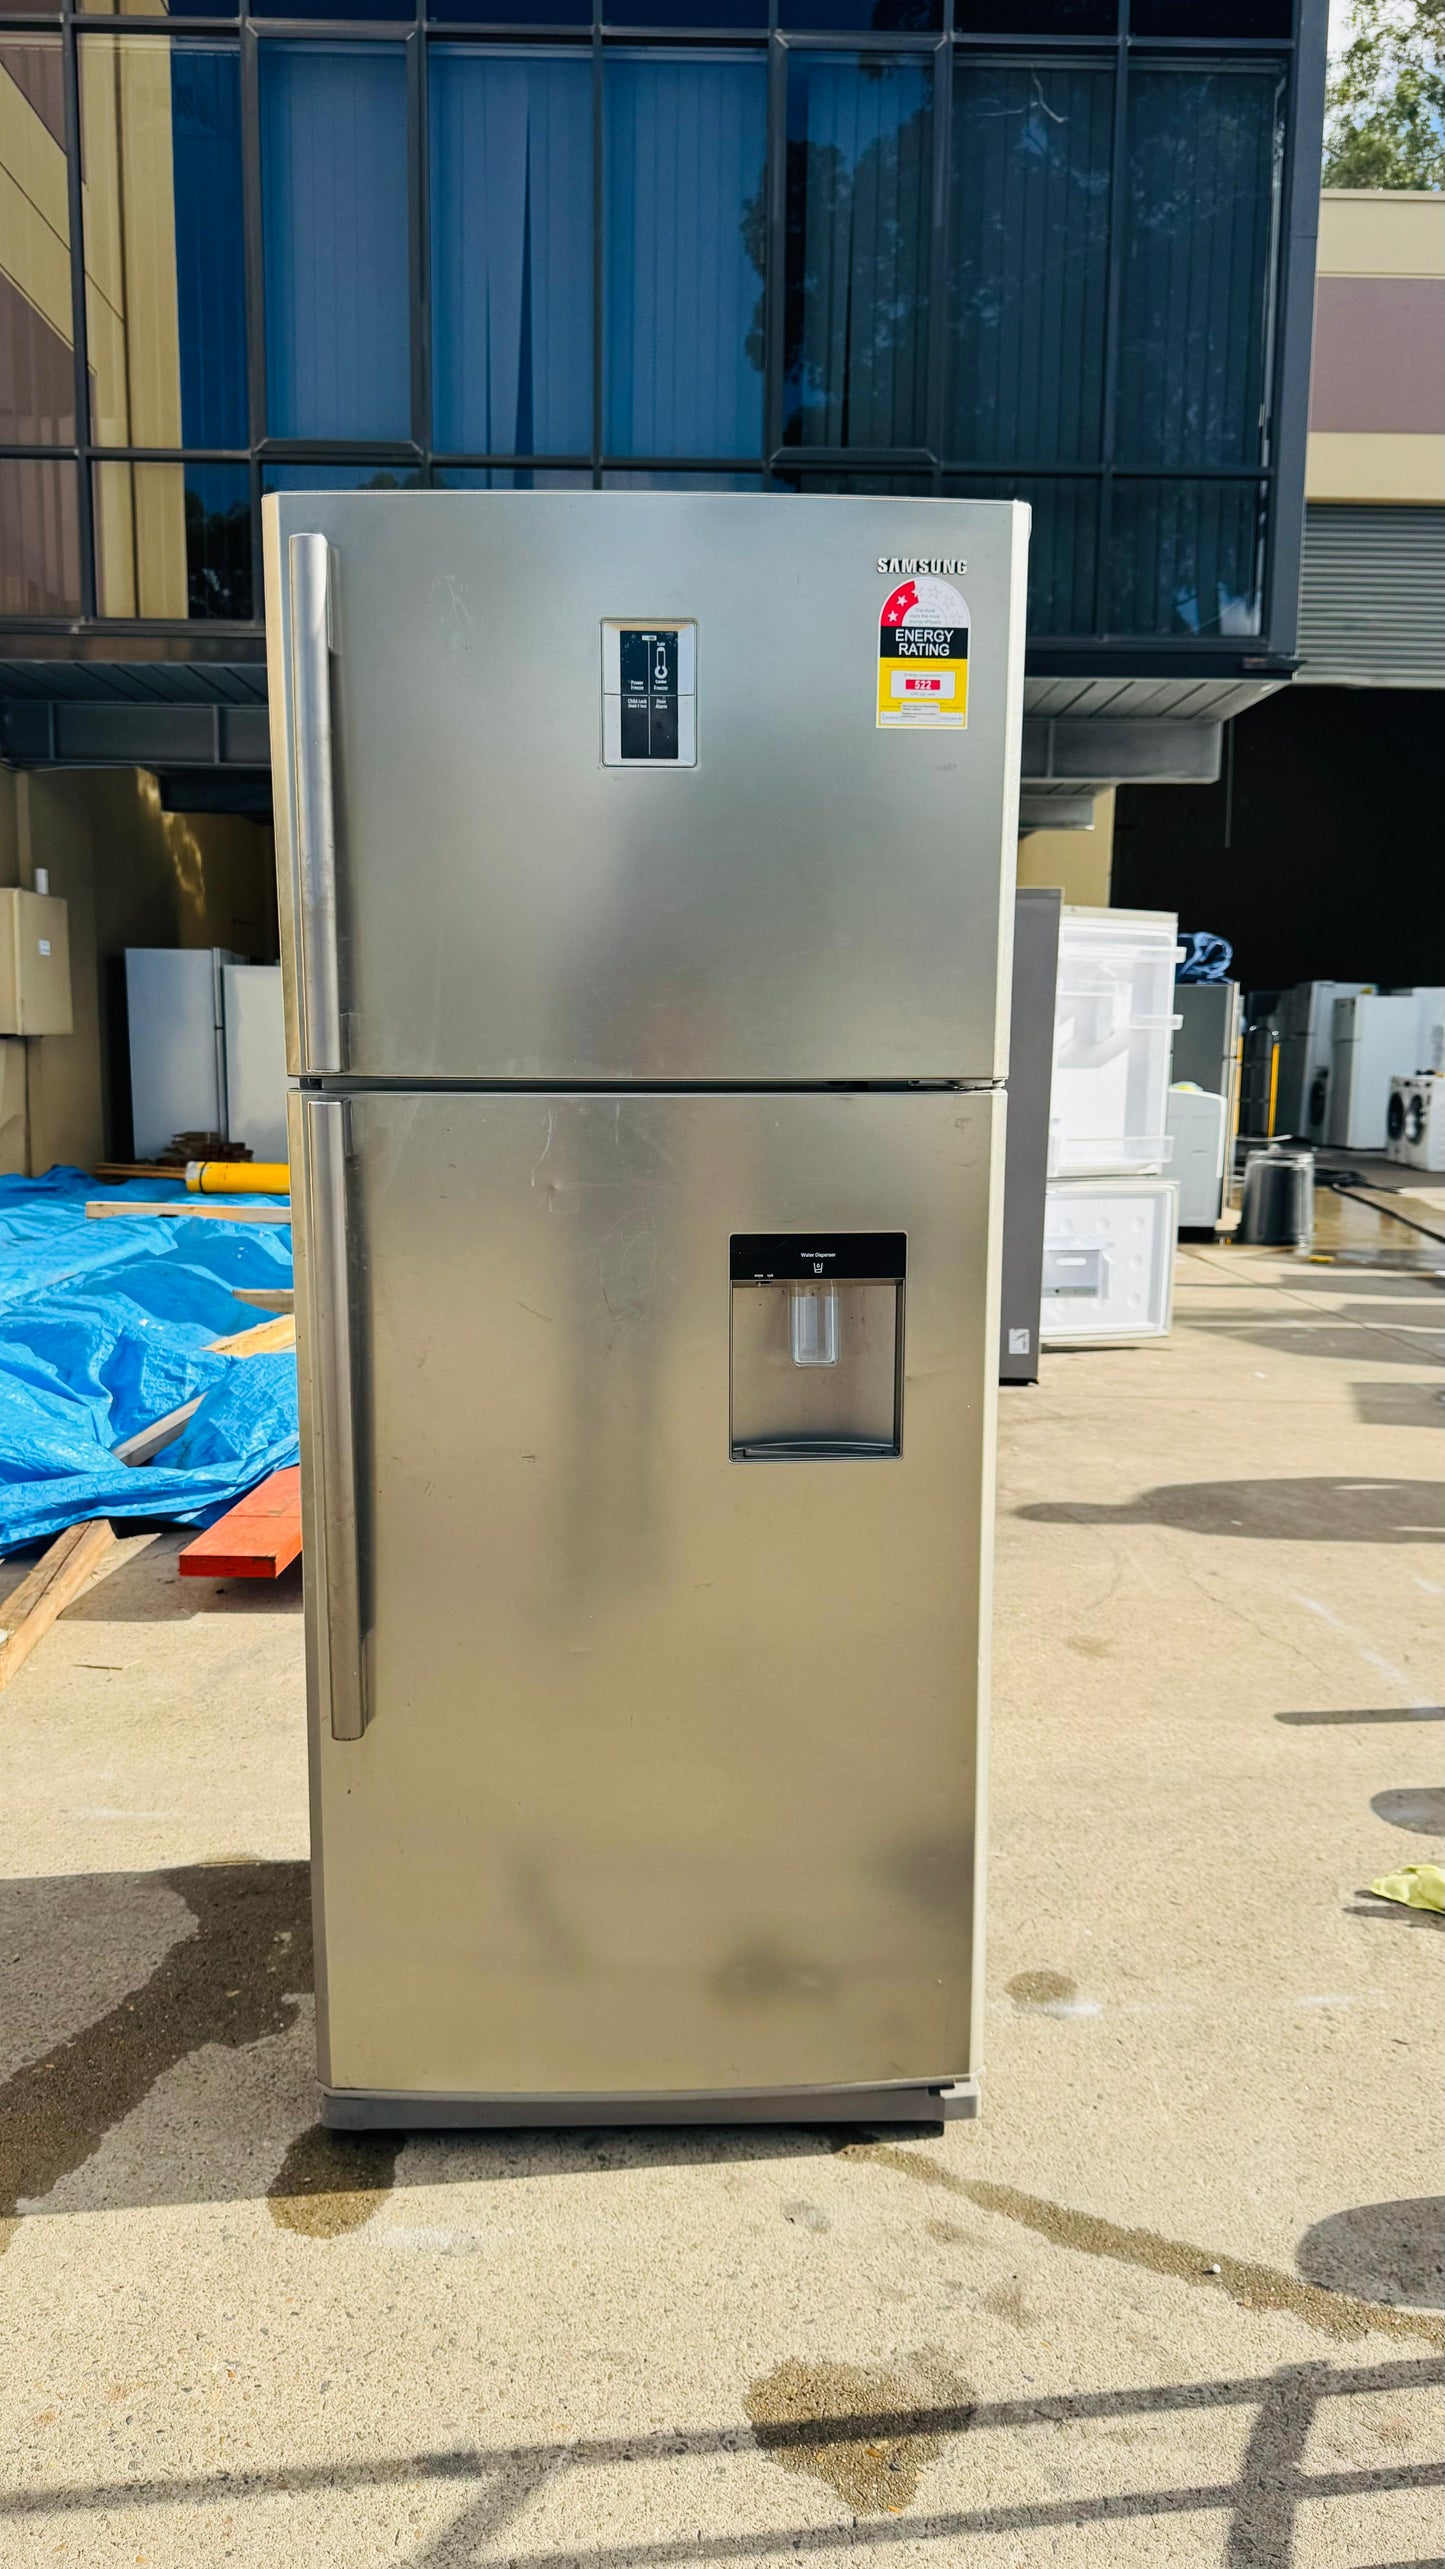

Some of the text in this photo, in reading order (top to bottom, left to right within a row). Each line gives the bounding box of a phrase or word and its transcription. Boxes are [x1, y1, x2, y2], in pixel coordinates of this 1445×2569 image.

[877, 557, 968, 575] SAMSUNG
[895, 629, 954, 643] ENERGY
[898, 643, 950, 656] RATING
[914, 680, 932, 690] 522
